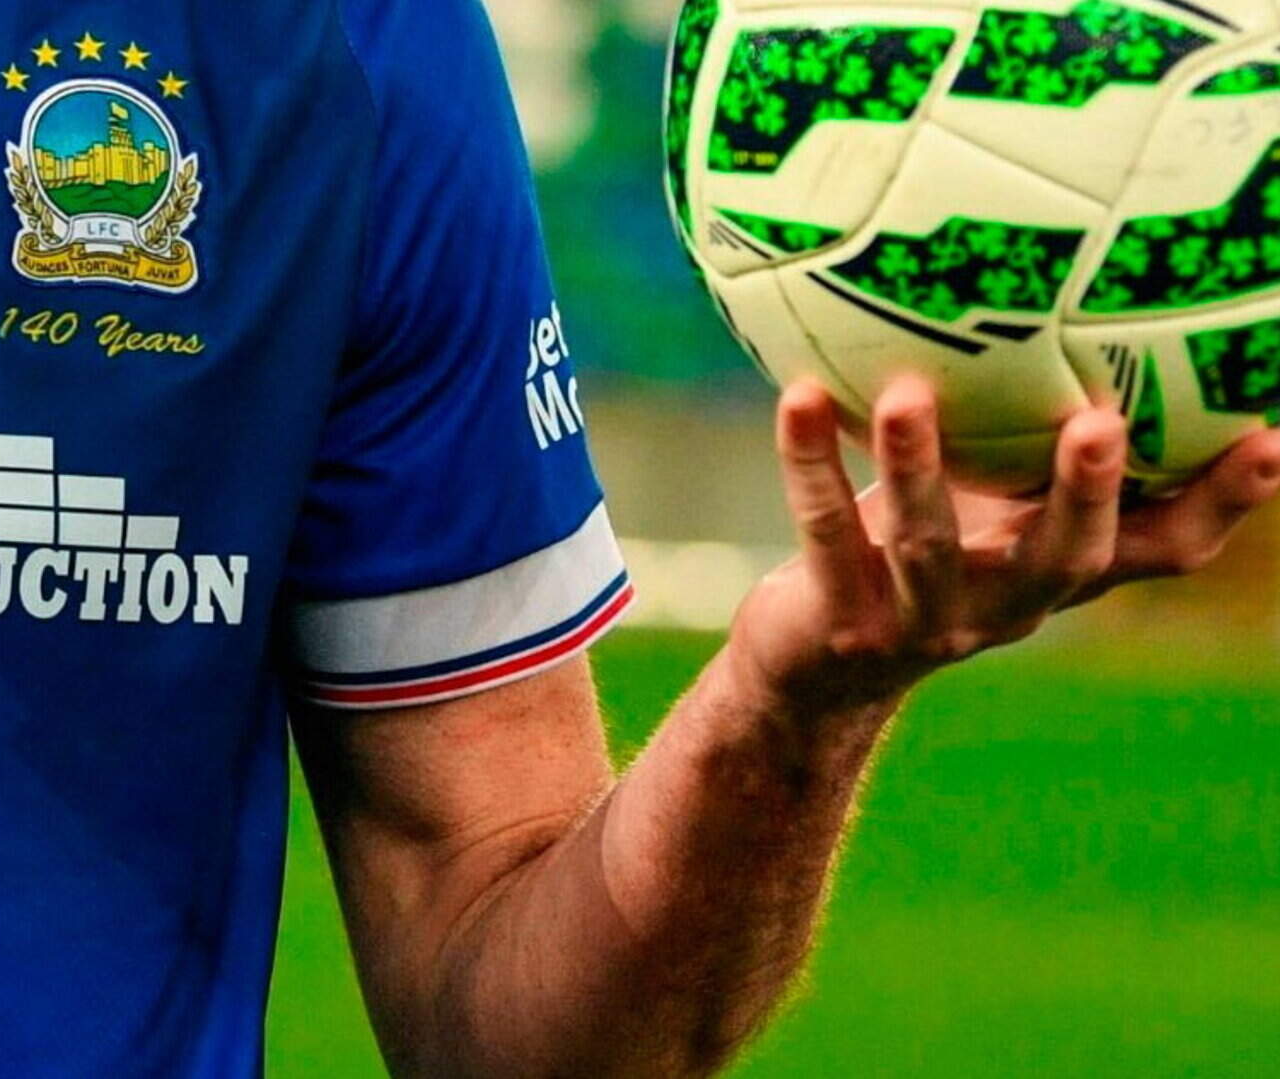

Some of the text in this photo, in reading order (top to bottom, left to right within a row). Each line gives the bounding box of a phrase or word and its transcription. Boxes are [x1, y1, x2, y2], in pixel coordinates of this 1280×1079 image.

[87, 222, 120, 237] LFC
[77, 260, 130, 276] FORTUNA
[146, 267, 181, 281] JUVAT
[0, 307, 204, 357] 140 Years
